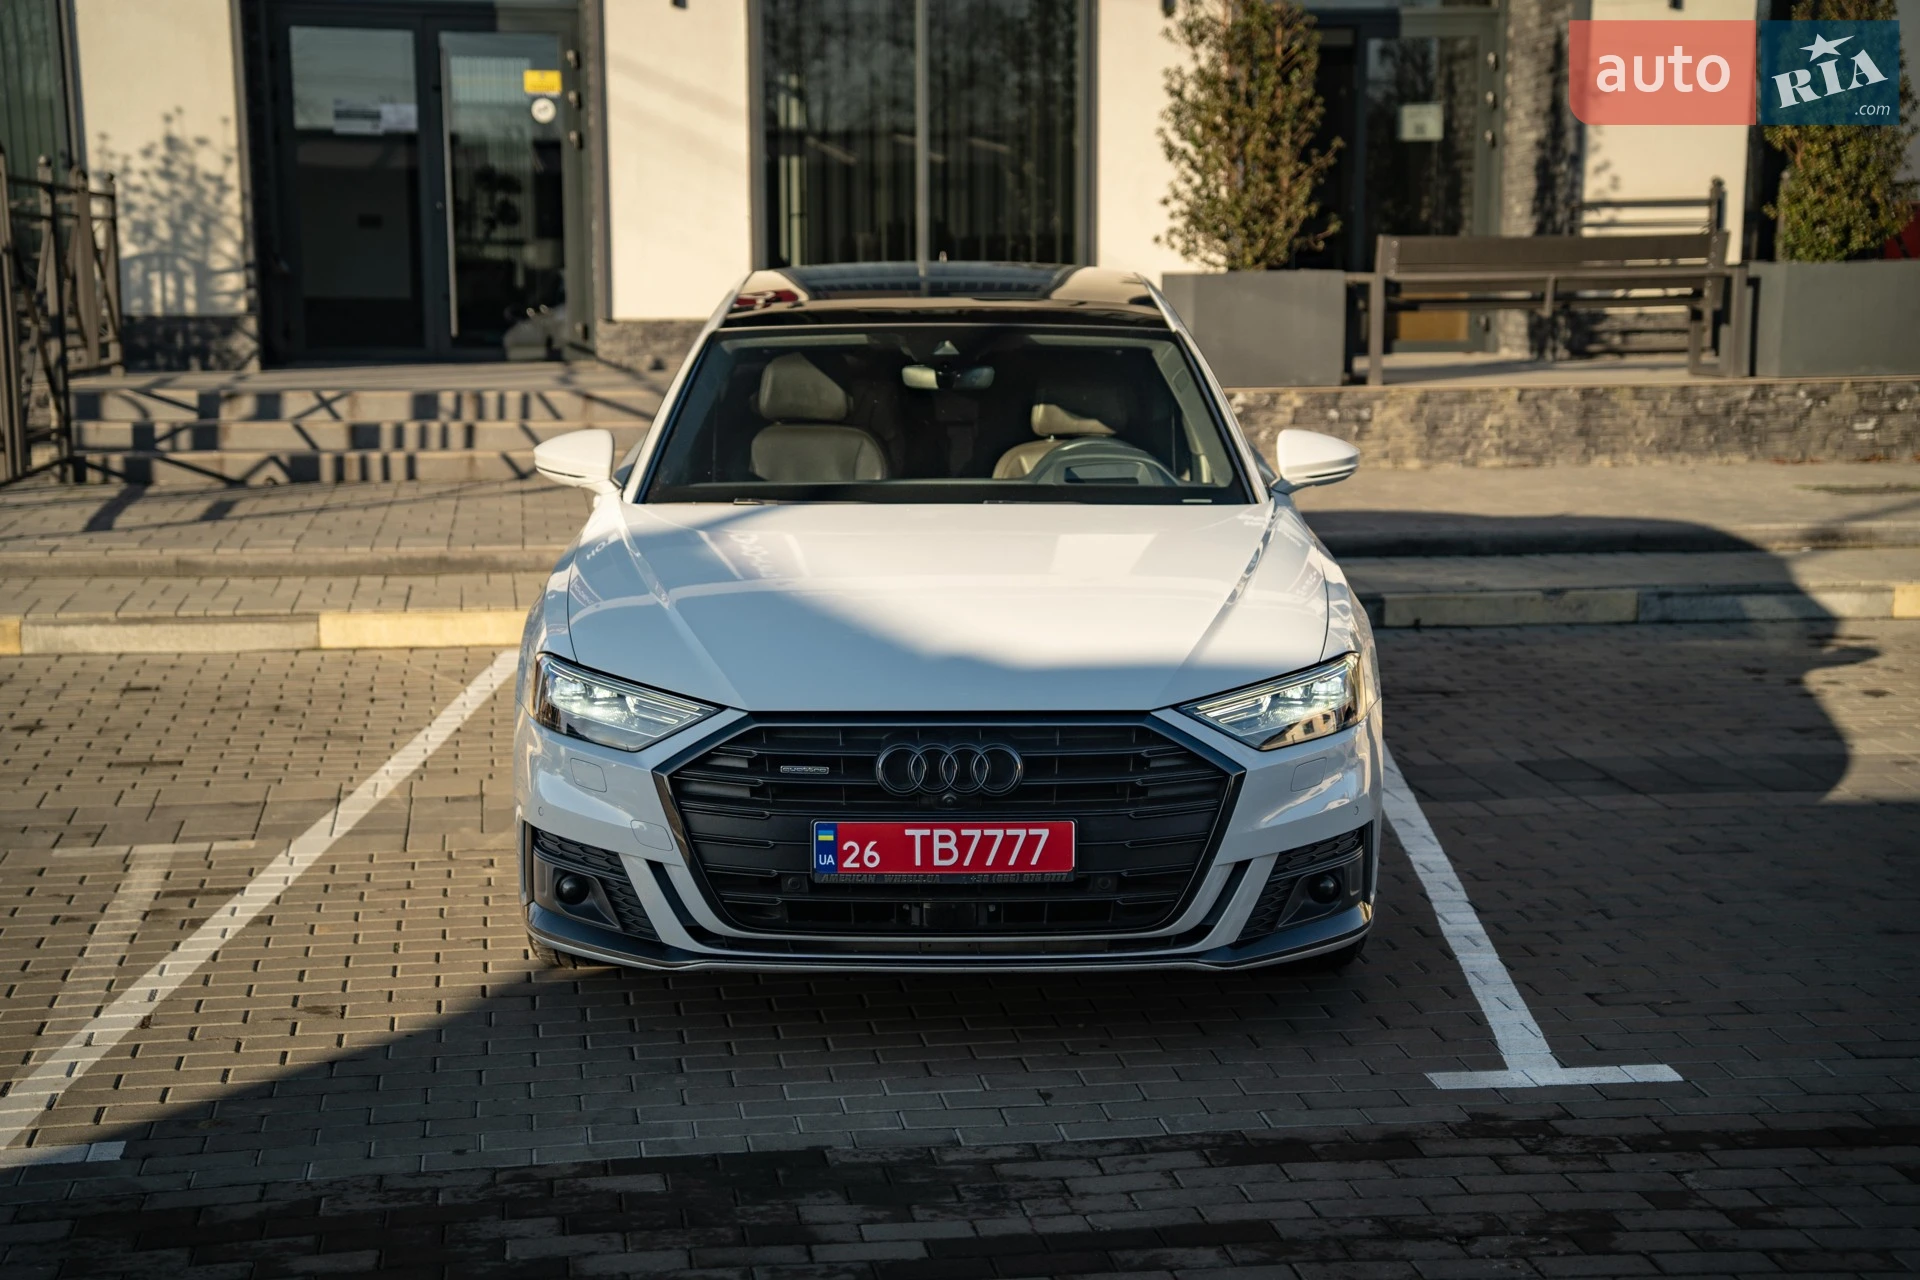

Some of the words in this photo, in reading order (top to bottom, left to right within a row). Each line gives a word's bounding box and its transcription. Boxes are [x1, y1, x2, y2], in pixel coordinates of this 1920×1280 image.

[781, 766, 828, 774] quattro
[842, 841, 881, 868] 26
[904, 828, 1050, 867] TB7777
[819, 854, 835, 866] UA
[820, 873, 876, 883] AMERICAN
